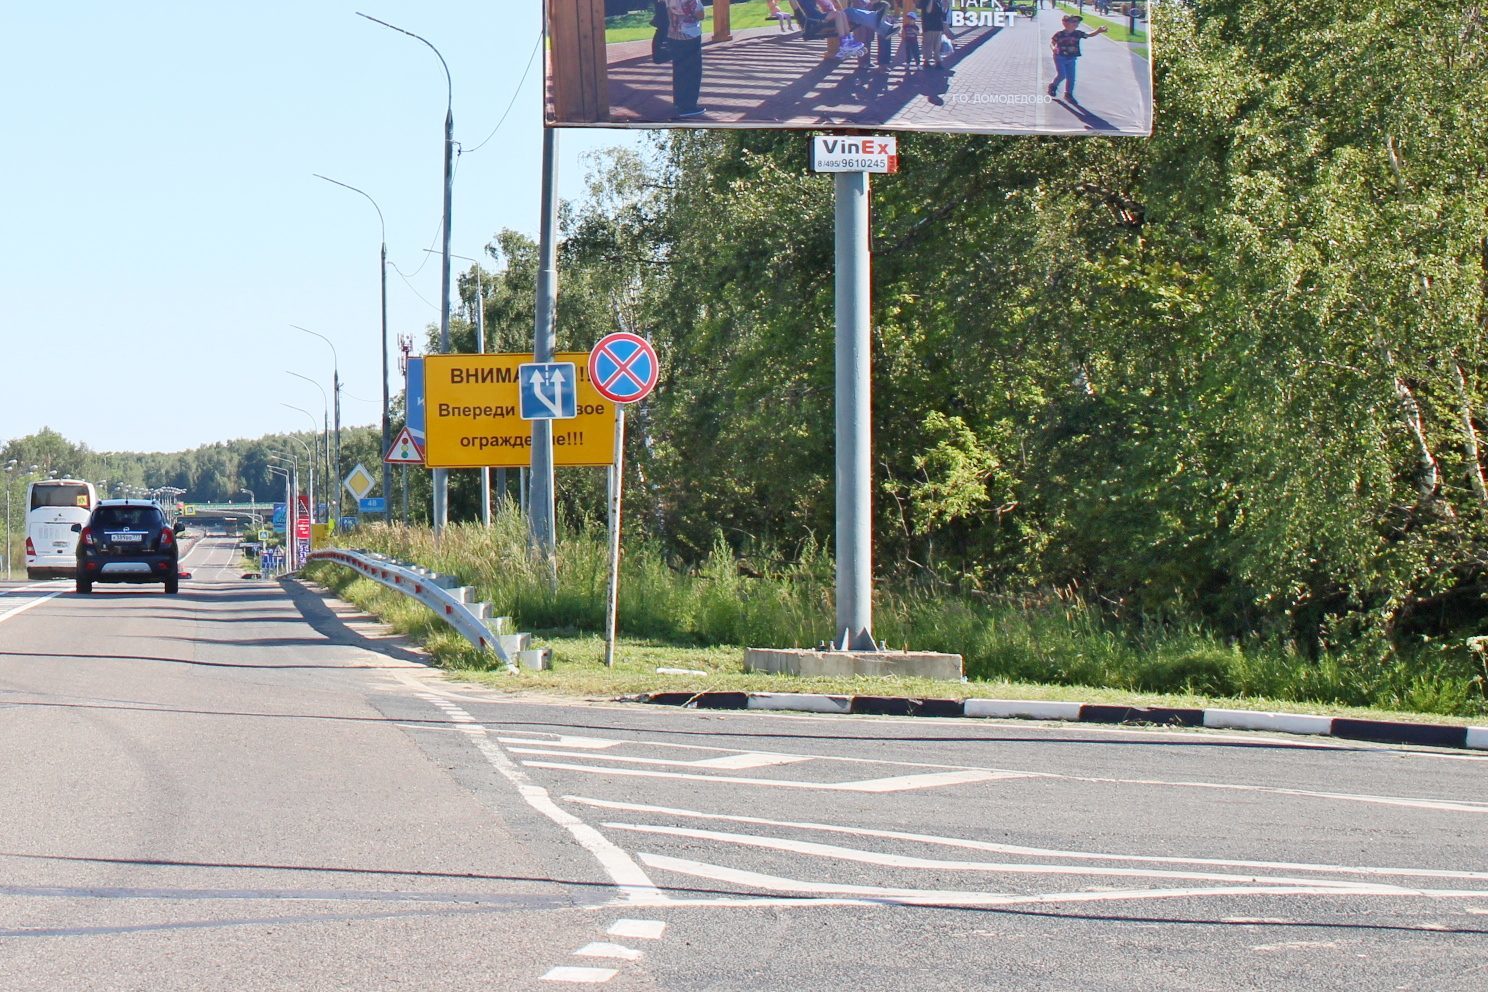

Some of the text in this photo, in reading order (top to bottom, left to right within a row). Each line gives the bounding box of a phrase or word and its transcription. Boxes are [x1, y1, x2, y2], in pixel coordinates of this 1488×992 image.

[950, 8, 1018, 27] ВЗЛЁТ
[973, 93, 1053, 105] ДОМОДЕДОВО
[822, 139, 889, 155] VinEx
[438, 403, 516, 420] Впереди
